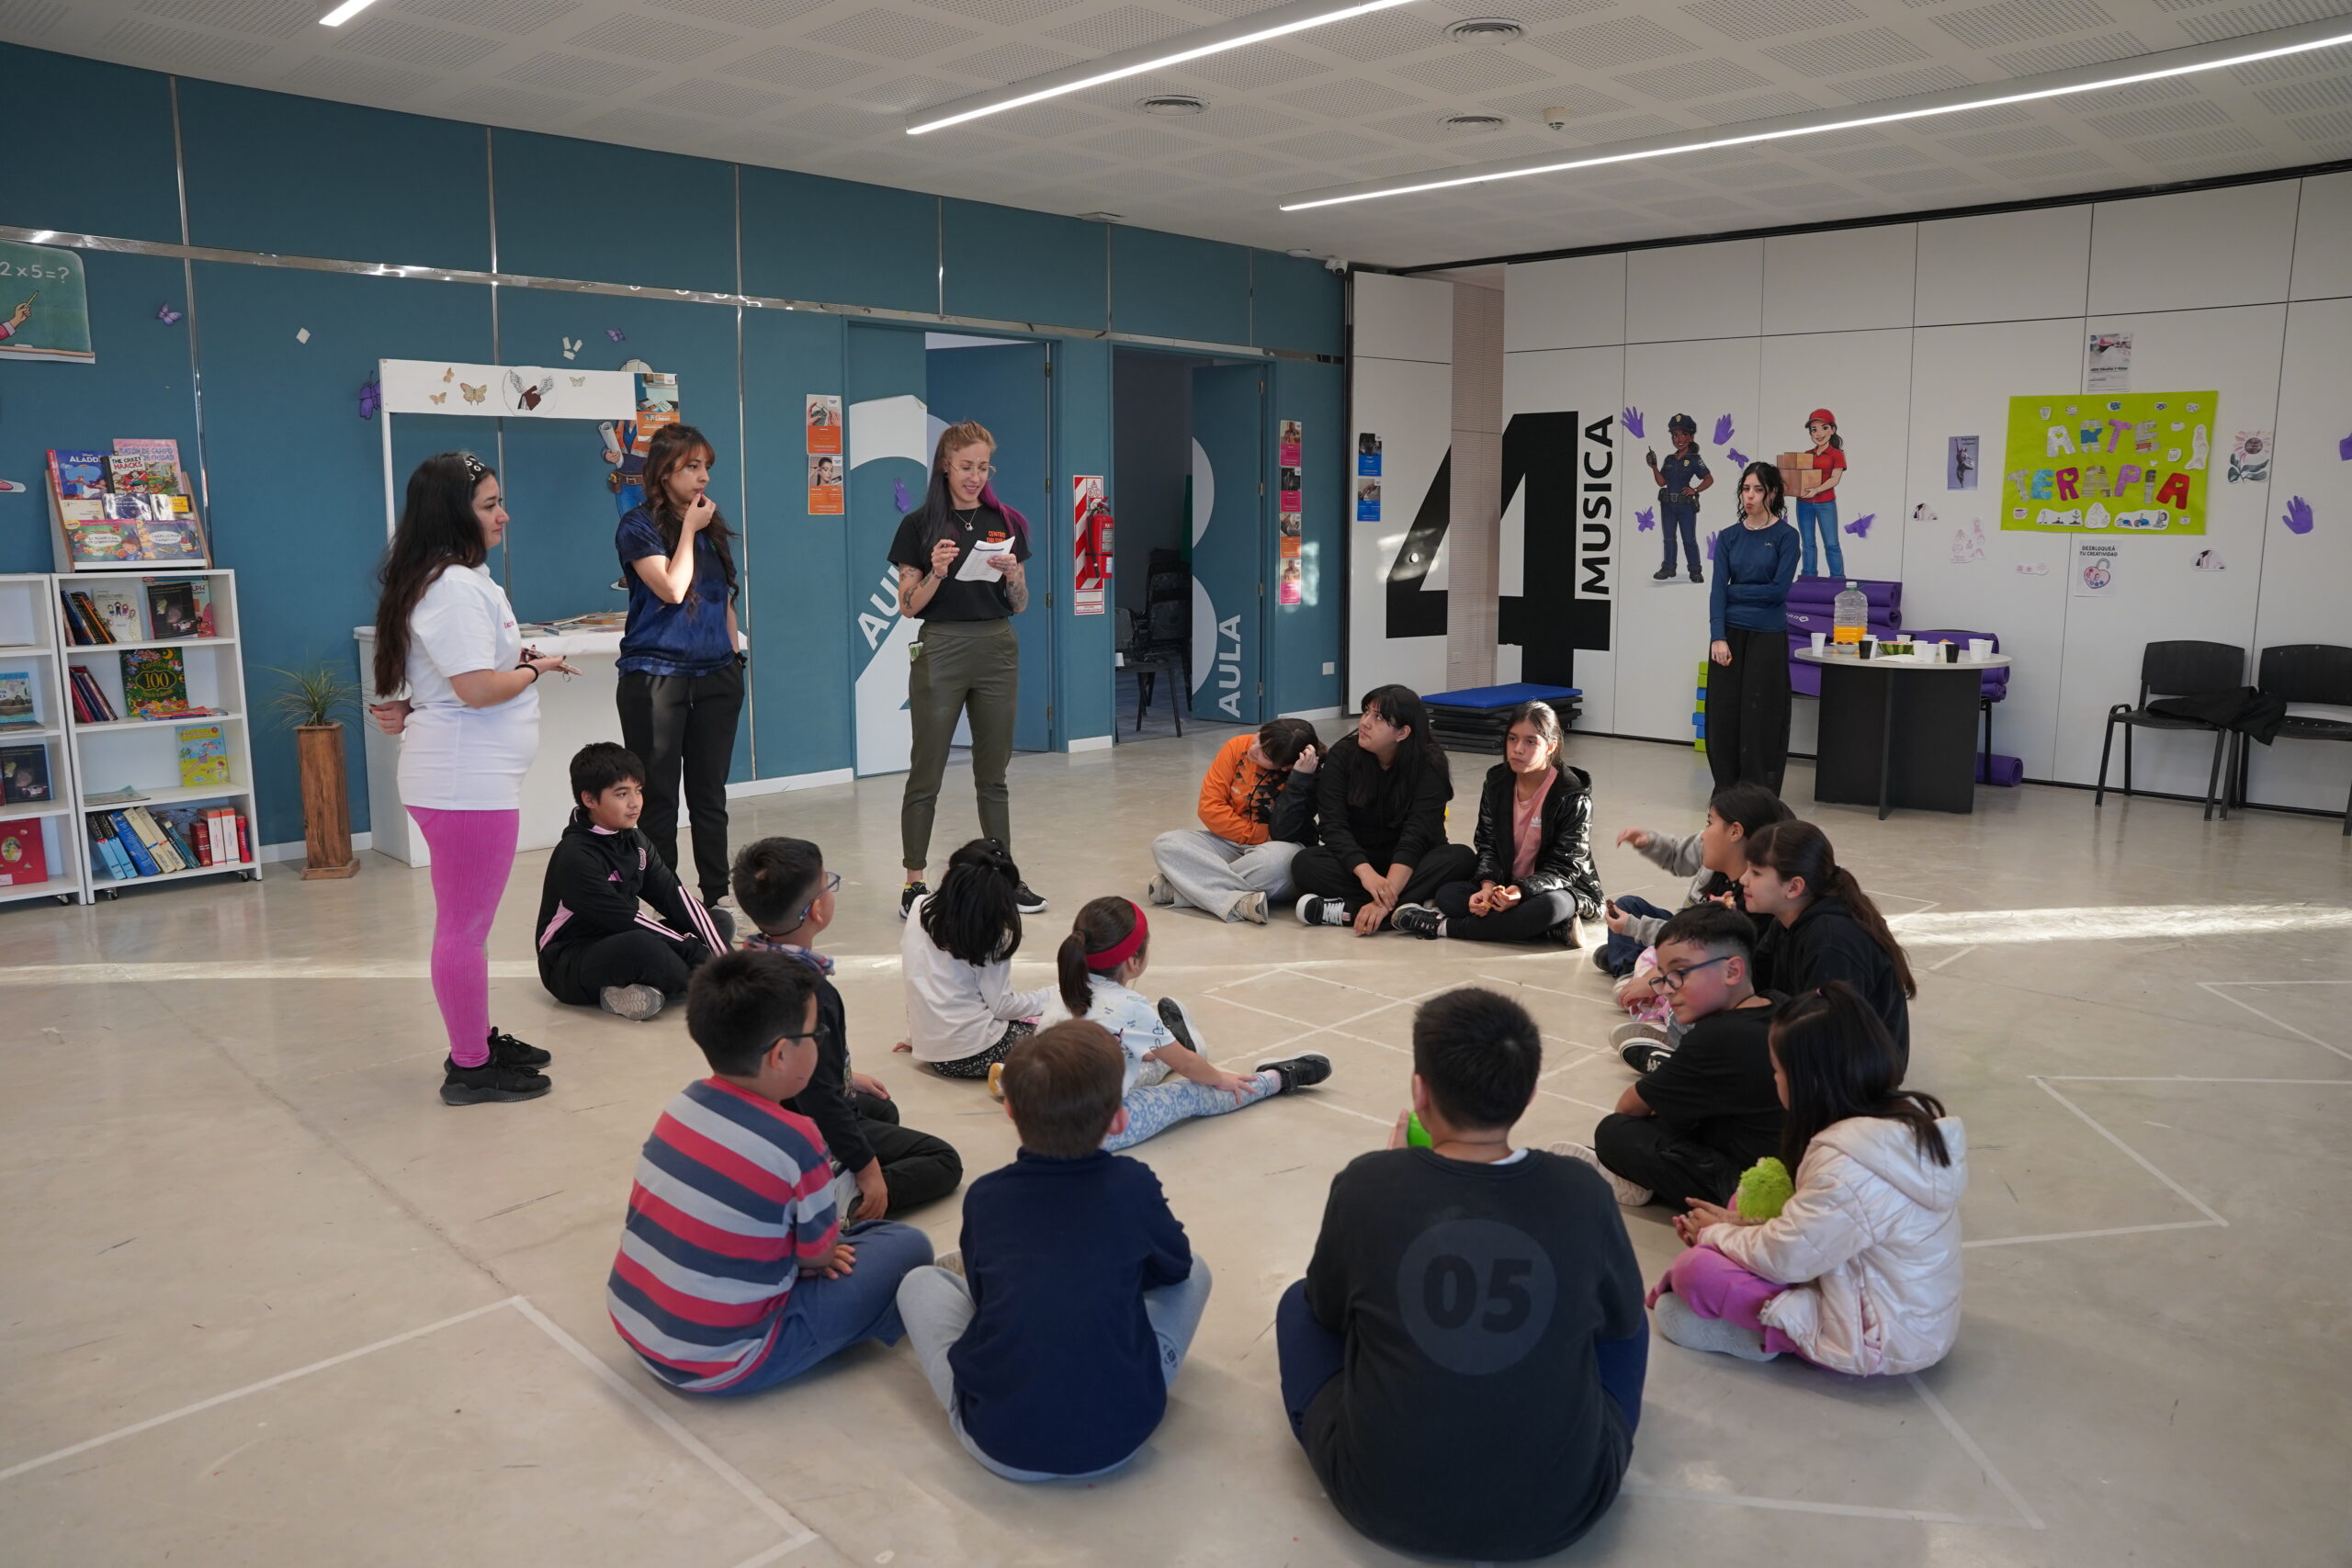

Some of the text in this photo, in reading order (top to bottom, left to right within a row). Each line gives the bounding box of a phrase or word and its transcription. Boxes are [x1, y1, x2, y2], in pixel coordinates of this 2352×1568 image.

[2046, 419, 2161, 458] ARTE
[1581, 414, 1613, 595] MUSICA
[143, 672, 169, 689] 100
[1218, 614, 1241, 718] AULA
[1423, 1255, 1532, 1334] 05
